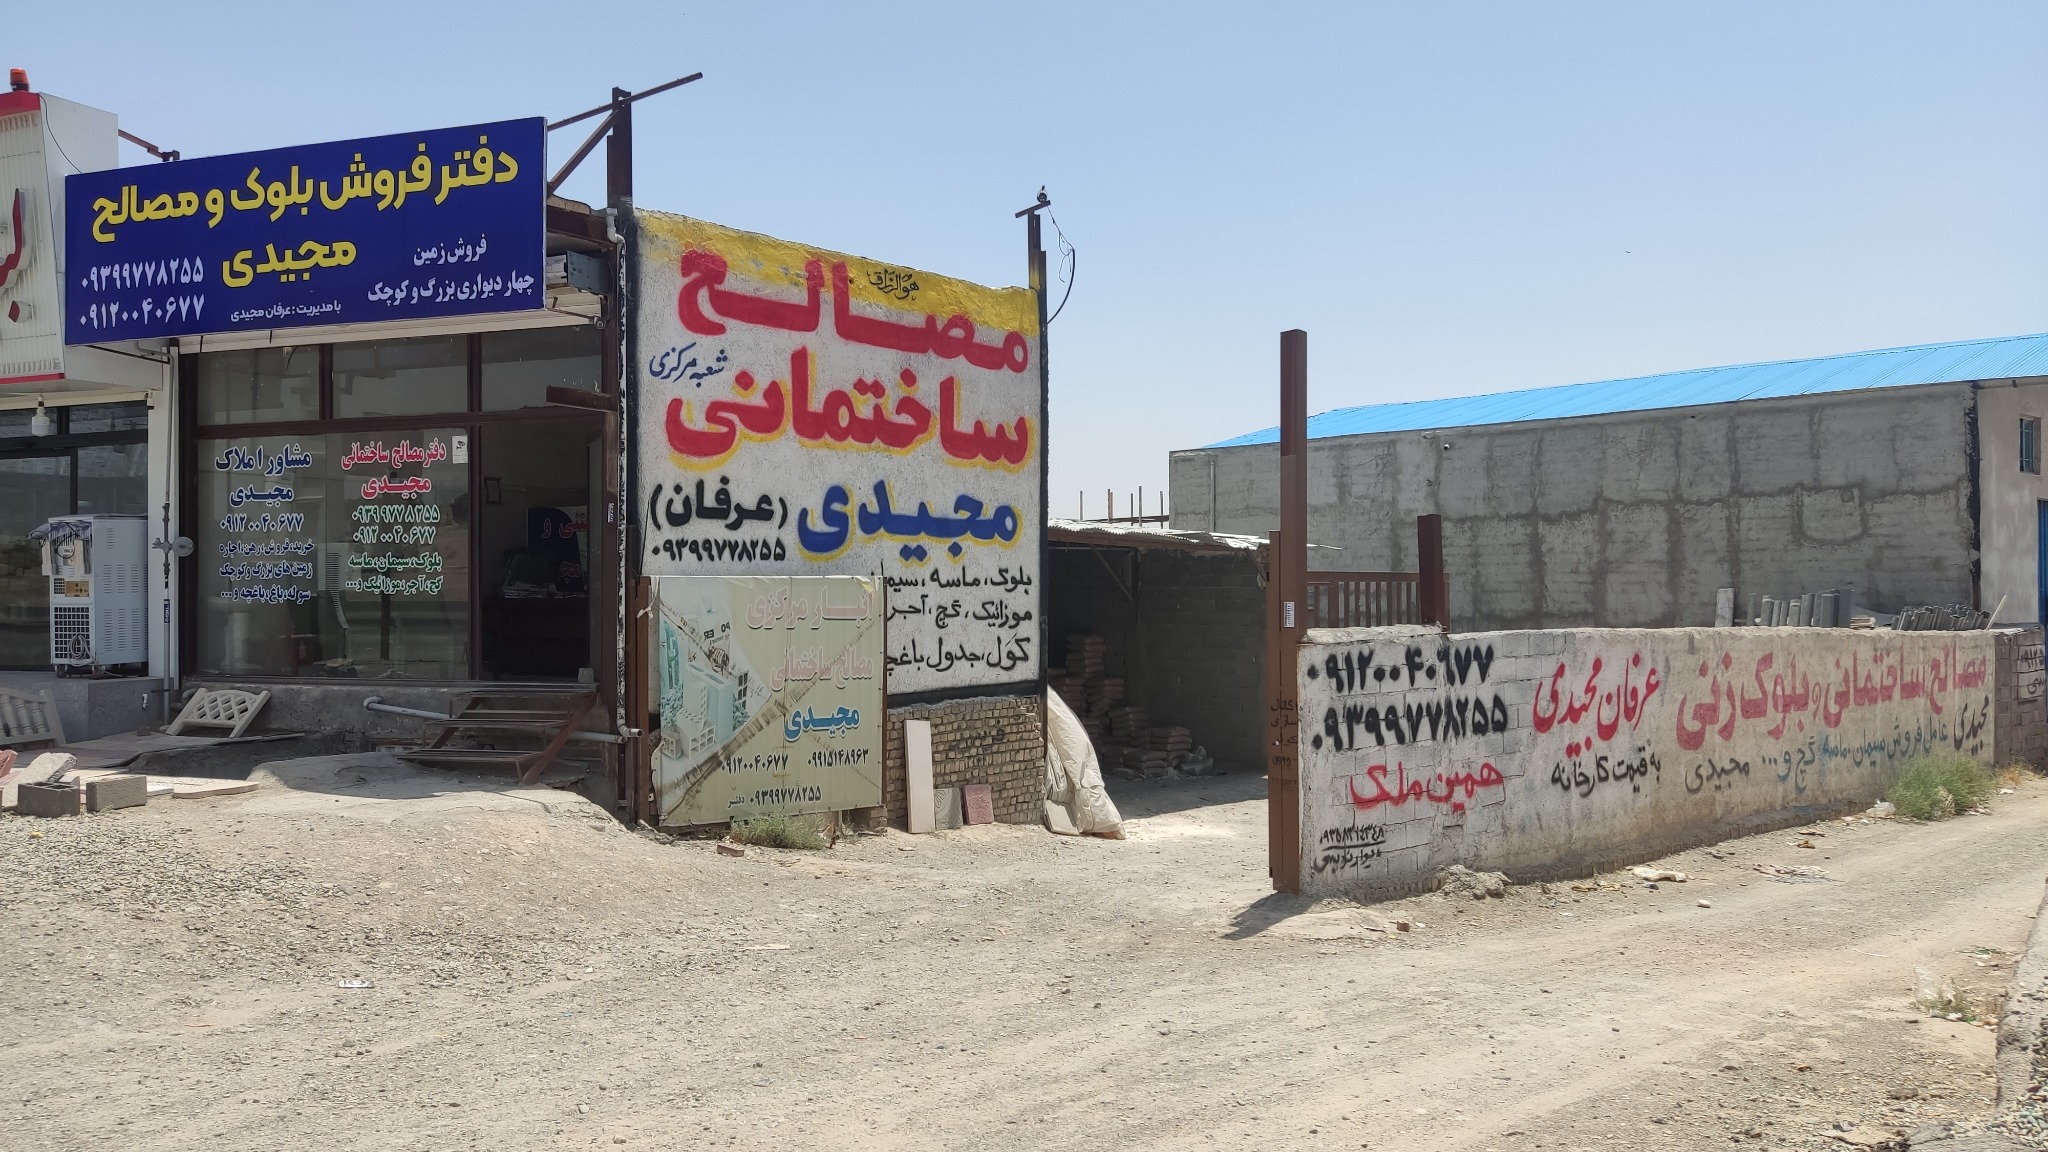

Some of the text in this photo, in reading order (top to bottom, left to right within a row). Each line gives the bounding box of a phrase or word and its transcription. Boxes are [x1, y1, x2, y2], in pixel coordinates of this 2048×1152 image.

[92, 135, 519, 243] دفتر فروش بلوک و مصالح
[222, 239, 357, 288] مجیدی
[413, 233, 487, 266] فروش زمین
[81, 256, 204, 292] ۰۹۳۹۹۷۷۸۲۵۵
[367, 269, 535, 307] چهار دیواری بزرگ و کوچک
[80, 293, 205, 330] ۰۹۱۲۰۰۴۰۶۷۷
[230, 308, 265, 322] مجیدی
[265, 302, 291, 319] عرفان
[677, 246, 1030, 374] مصالح
[649, 342, 728, 388] شعبه مرکزی
[665, 345, 1032, 471] ساختمانی
[264, 443, 312, 476] مشاور
[341, 437, 447, 471] دفتر مصالح ساختمانی
[229, 484, 295, 508] مجیدی
[360, 475, 432, 500] مجیدی
[797, 479, 1022, 564] مجیدی
[251, 561, 274, 580] بزرگ
[291, 562, 313, 579] زمین
[650, 537, 787, 564] ۰۹۳۹۹۷۷۸۲۵۵
[746, 586, 874, 630] انبار مرکزی
[769, 645, 873, 693] مصالح ساختمانی
[926, 637, 981, 672] جدول
[1928, 640, 1987, 716] مصالح
[1532, 652, 1660, 759] عرفان مجیدی
[1676, 651, 1737, 751] زنی
[1811, 681, 1822, 722] و
[784, 703, 861, 743] مجیدی
[1310, 694, 1508, 752] ۰۹۳۹۹۷۷۸۲۵۵
[1886, 715, 1923, 760] فروش
[1923, 714, 1949, 753] عامل
[1953, 694, 1990, 757] مجیدی
[1349, 761, 1504, 812] همین ملک
[1551, 753, 1609, 798] کارخانه
[1612, 745, 1648, 793] قیمت
[1684, 757, 1750, 796] مجیدی
